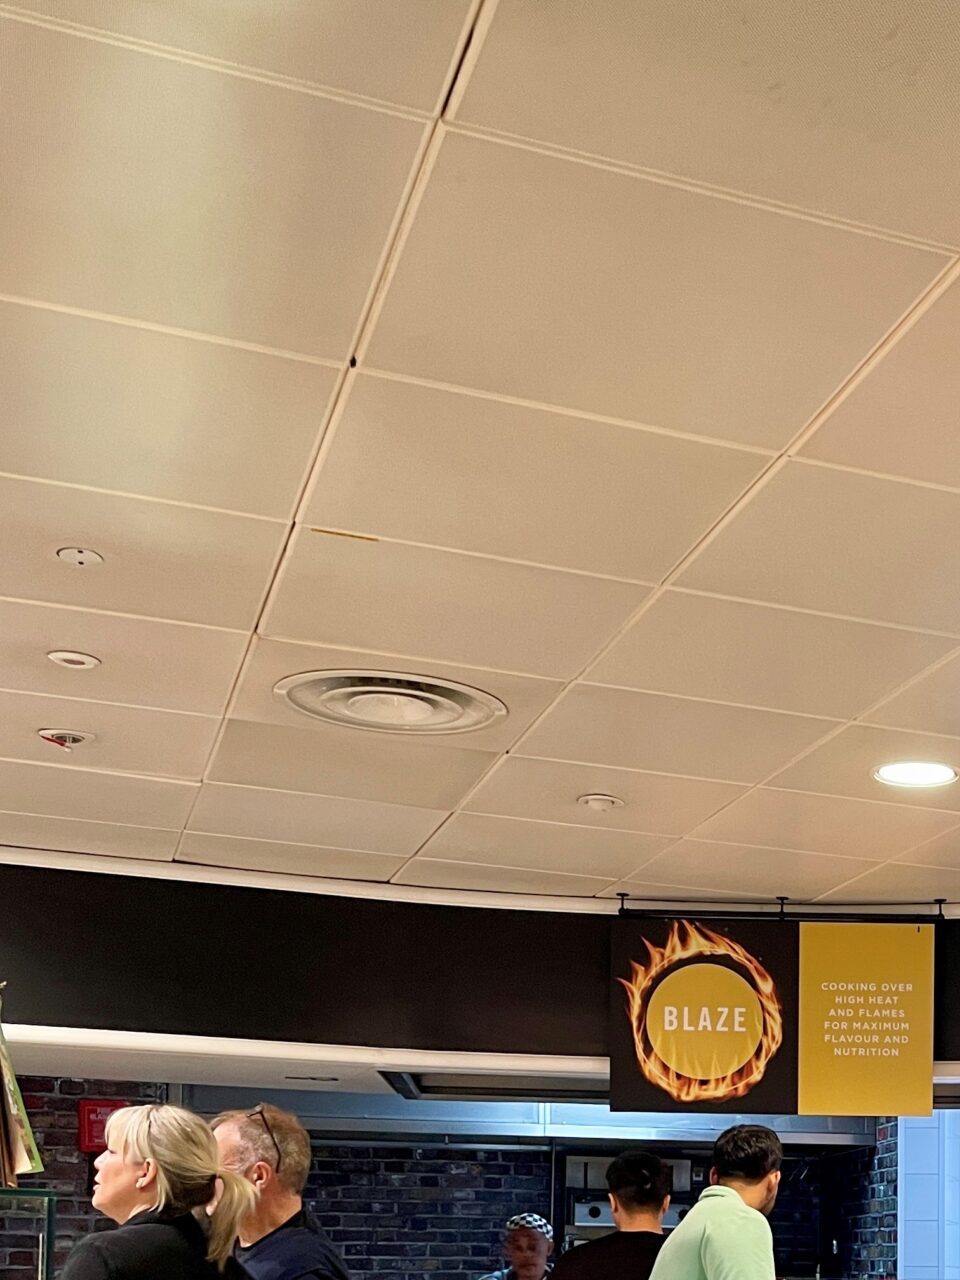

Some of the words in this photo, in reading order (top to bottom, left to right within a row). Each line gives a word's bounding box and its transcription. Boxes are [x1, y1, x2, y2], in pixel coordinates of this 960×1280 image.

[821, 982, 877, 992] COOKING
[881, 983, 913, 992] OVER
[834, 995, 864, 1005] HIGH
[868, 995, 899, 1005] HEAT
[828, 1008, 854, 1017] AND
[858, 1008, 905, 1018] FLAMES
[663, 1005, 747, 1032] BLAZE
[823, 1020, 848, 1030] FOR
[852, 1021, 910, 1031] MAXIMUM
[824, 1034, 880, 1044] FLAVOUR
[883, 1035, 909, 1044] AND
[833, 1047, 899, 1057] NUTRITION
